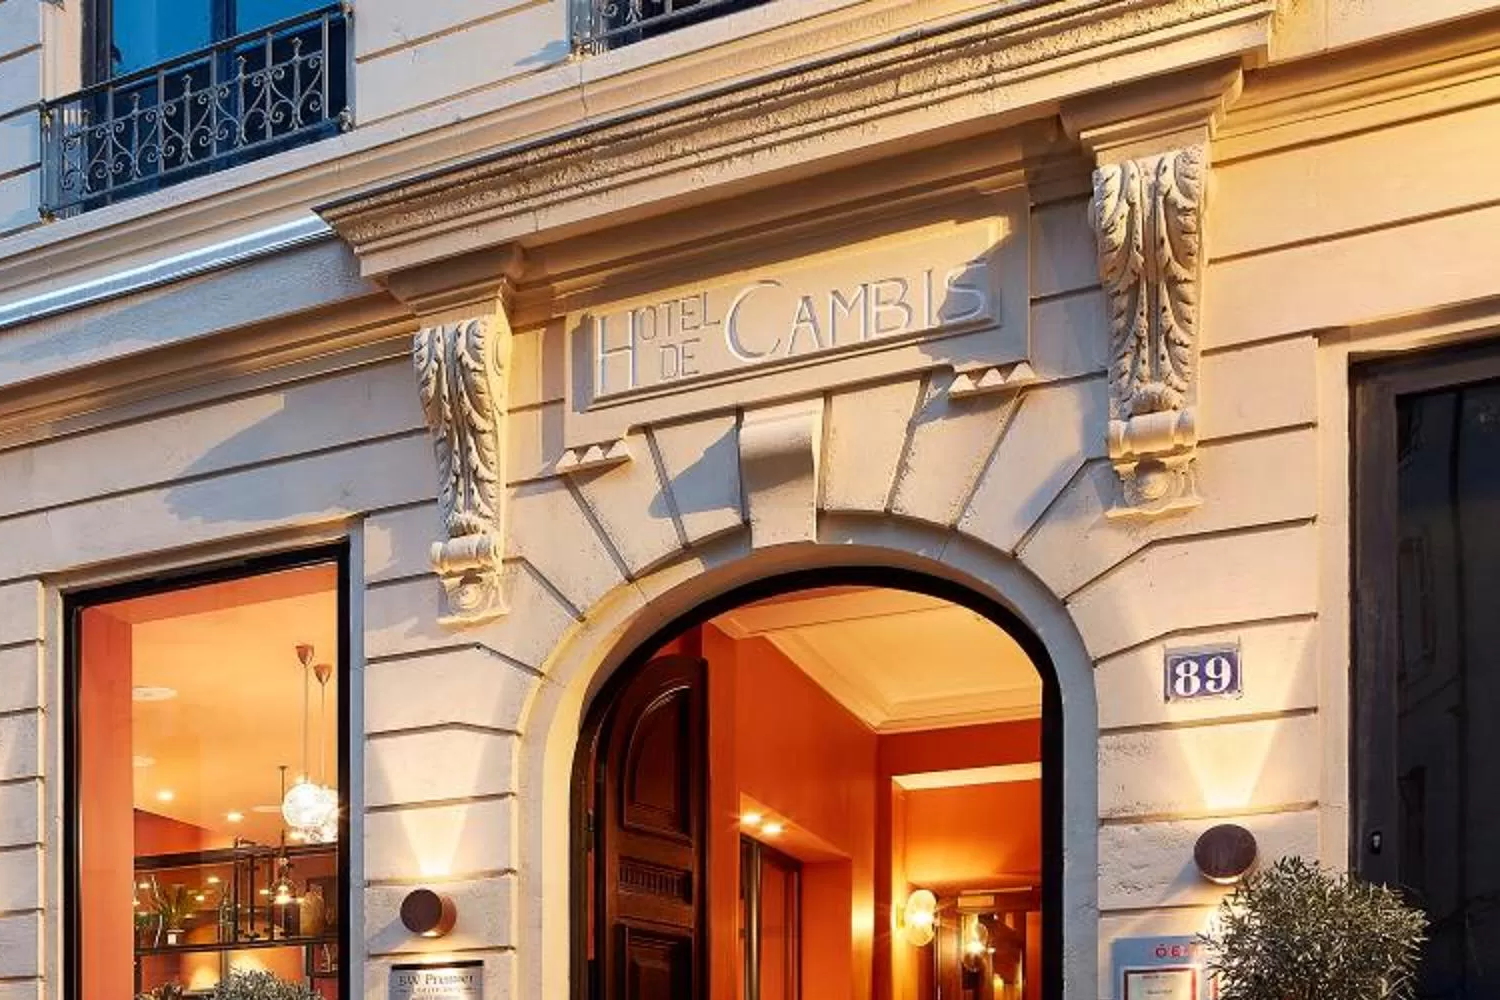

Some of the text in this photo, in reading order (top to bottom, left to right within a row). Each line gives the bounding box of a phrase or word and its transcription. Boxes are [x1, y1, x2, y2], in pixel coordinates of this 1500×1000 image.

[724, 262, 988, 364] CAMBIS
[659, 337, 700, 381] DE
[1174, 656, 1231, 696] 89
